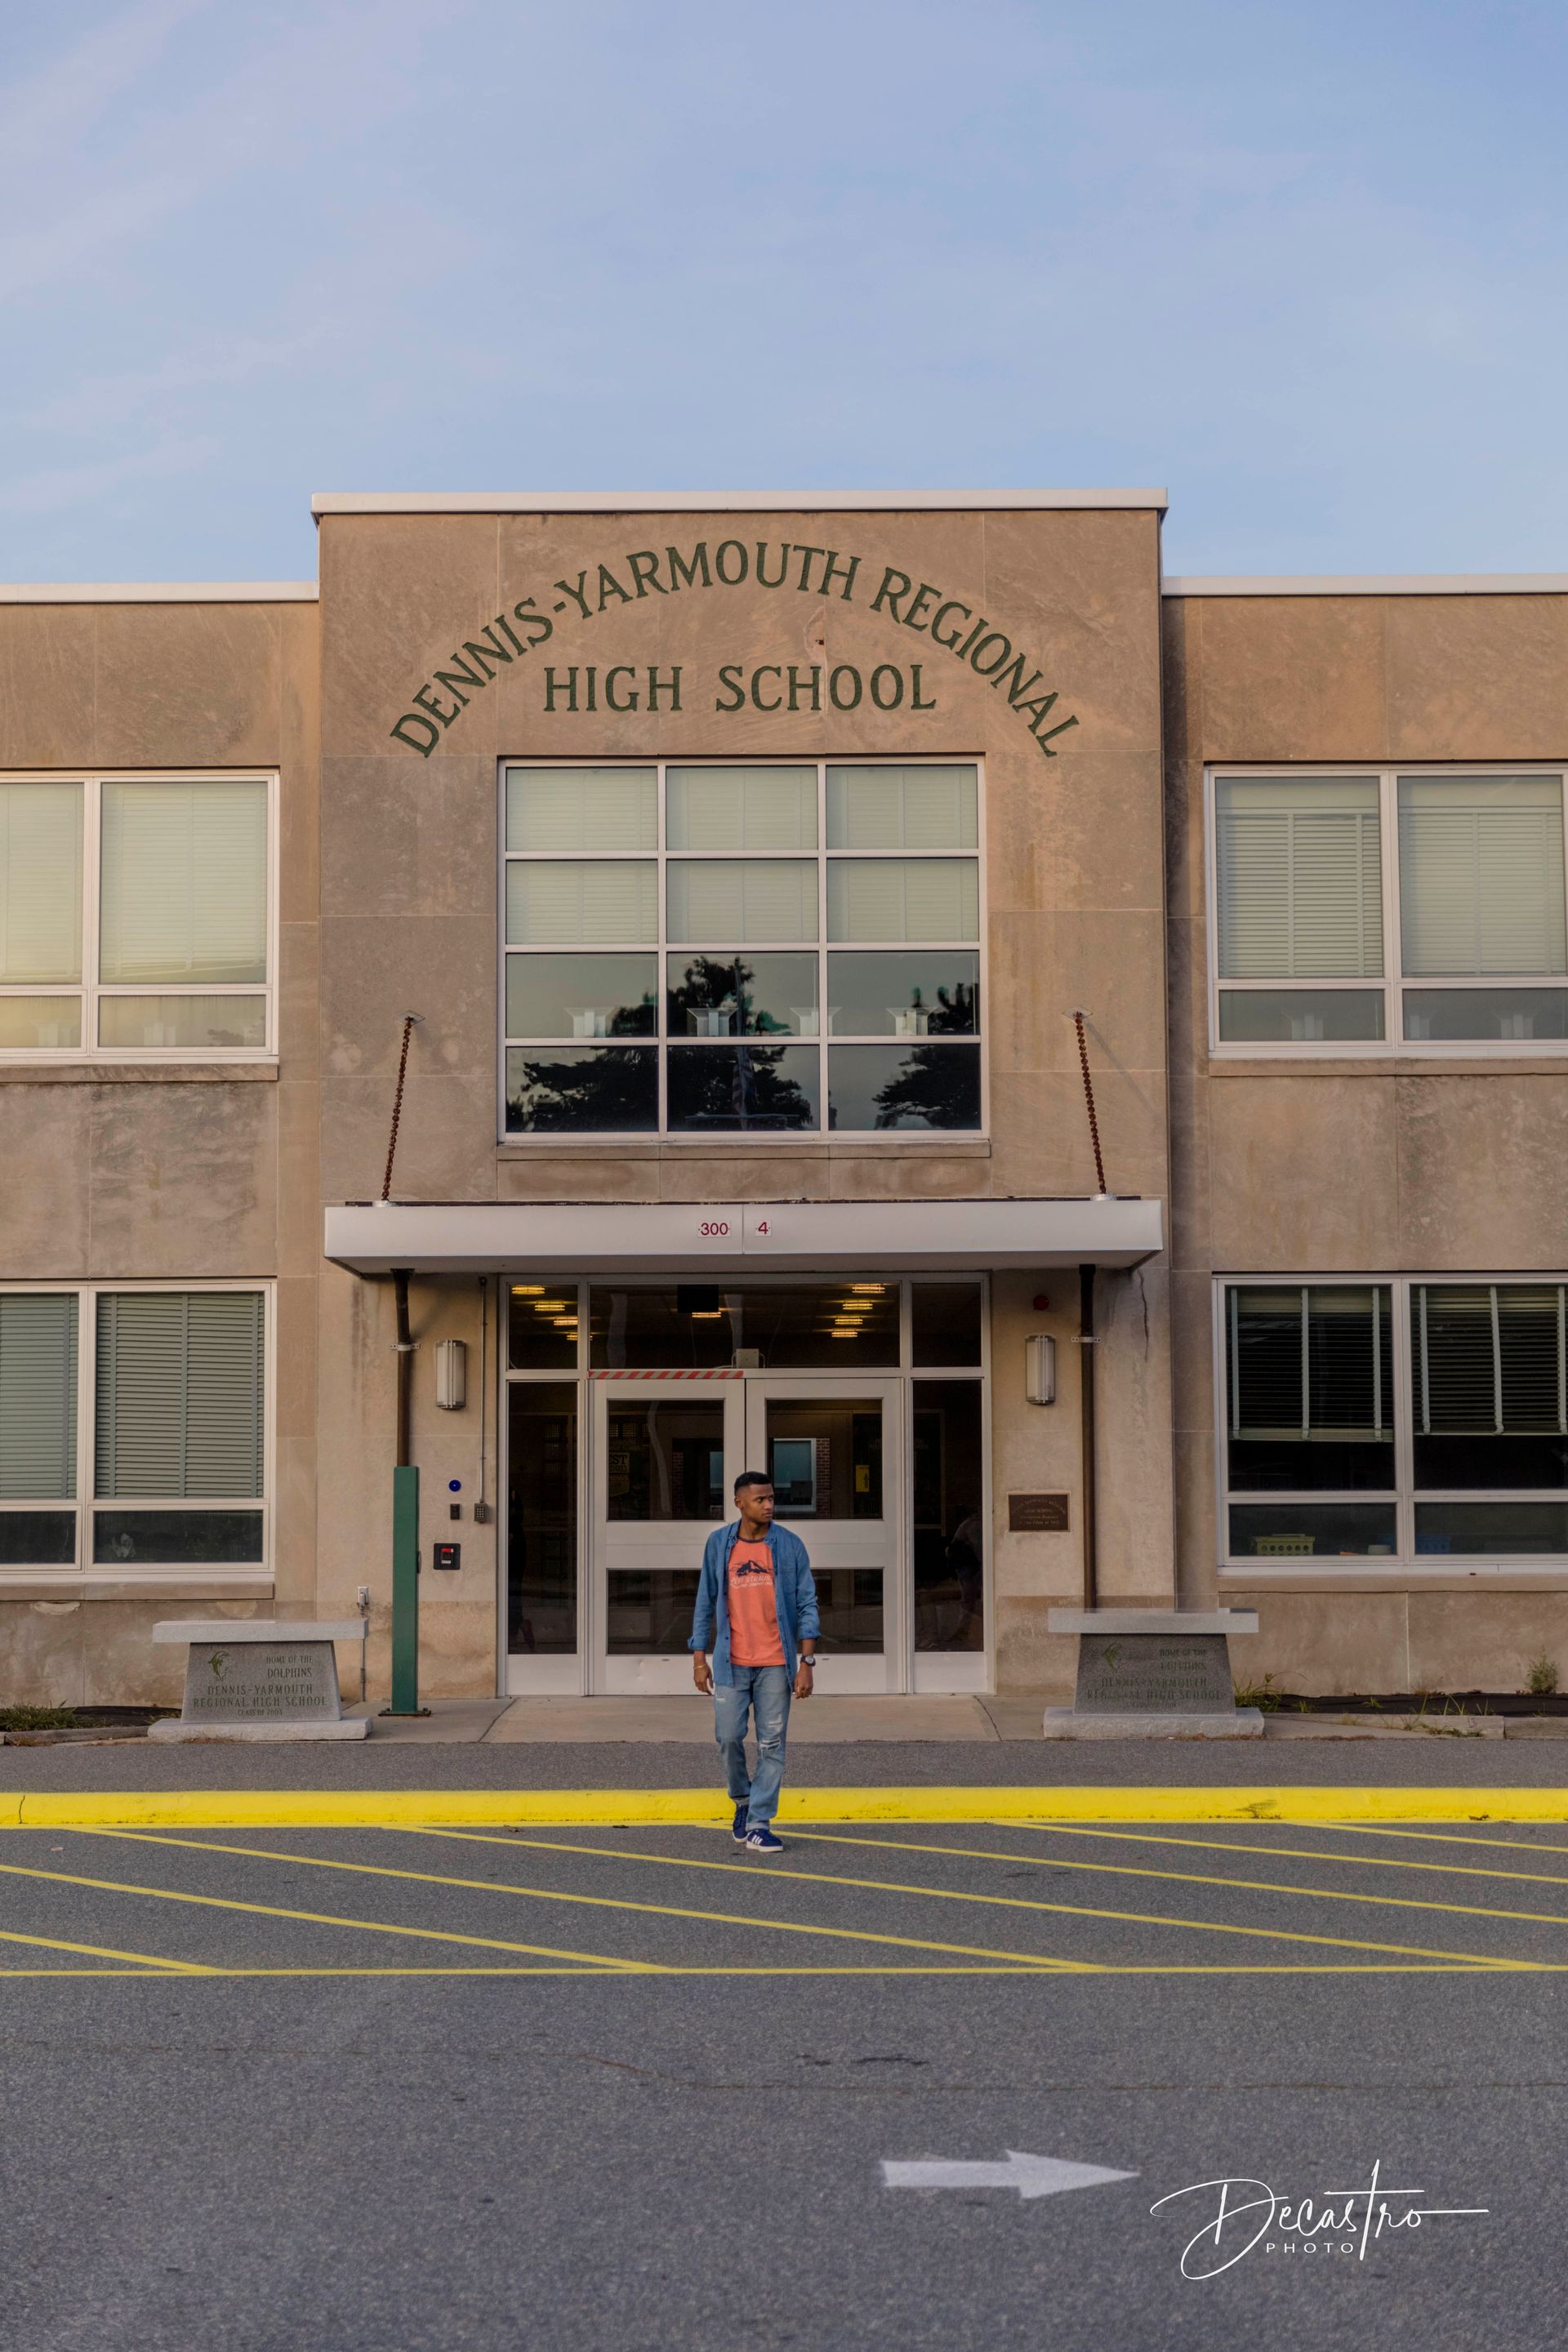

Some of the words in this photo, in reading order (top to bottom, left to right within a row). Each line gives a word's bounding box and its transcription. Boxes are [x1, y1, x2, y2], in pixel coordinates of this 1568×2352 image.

[390, 540, 862, 758] DENNIS-YARMOUTH
[870, 566, 1080, 758] REGIONAL
[543, 666, 683, 712] HIGH
[715, 664, 937, 711] SCHOOL
[701, 1222, 728, 1236] 300
[758, 1221, 768, 1235] 4
[266, 1655, 286, 1664] HOME
[287, 1655, 297, 1664] OF
[300, 1655, 313, 1664] THE
[267, 1667, 313, 1679] DOLPHINS
[207, 1684, 314, 1695] DENNIS-YARMOUTH
[193, 1697, 247, 1708] REGIONAL
[253, 1696, 280, 1707] HIGH
[286, 1695, 327, 1706] SCHOOL
